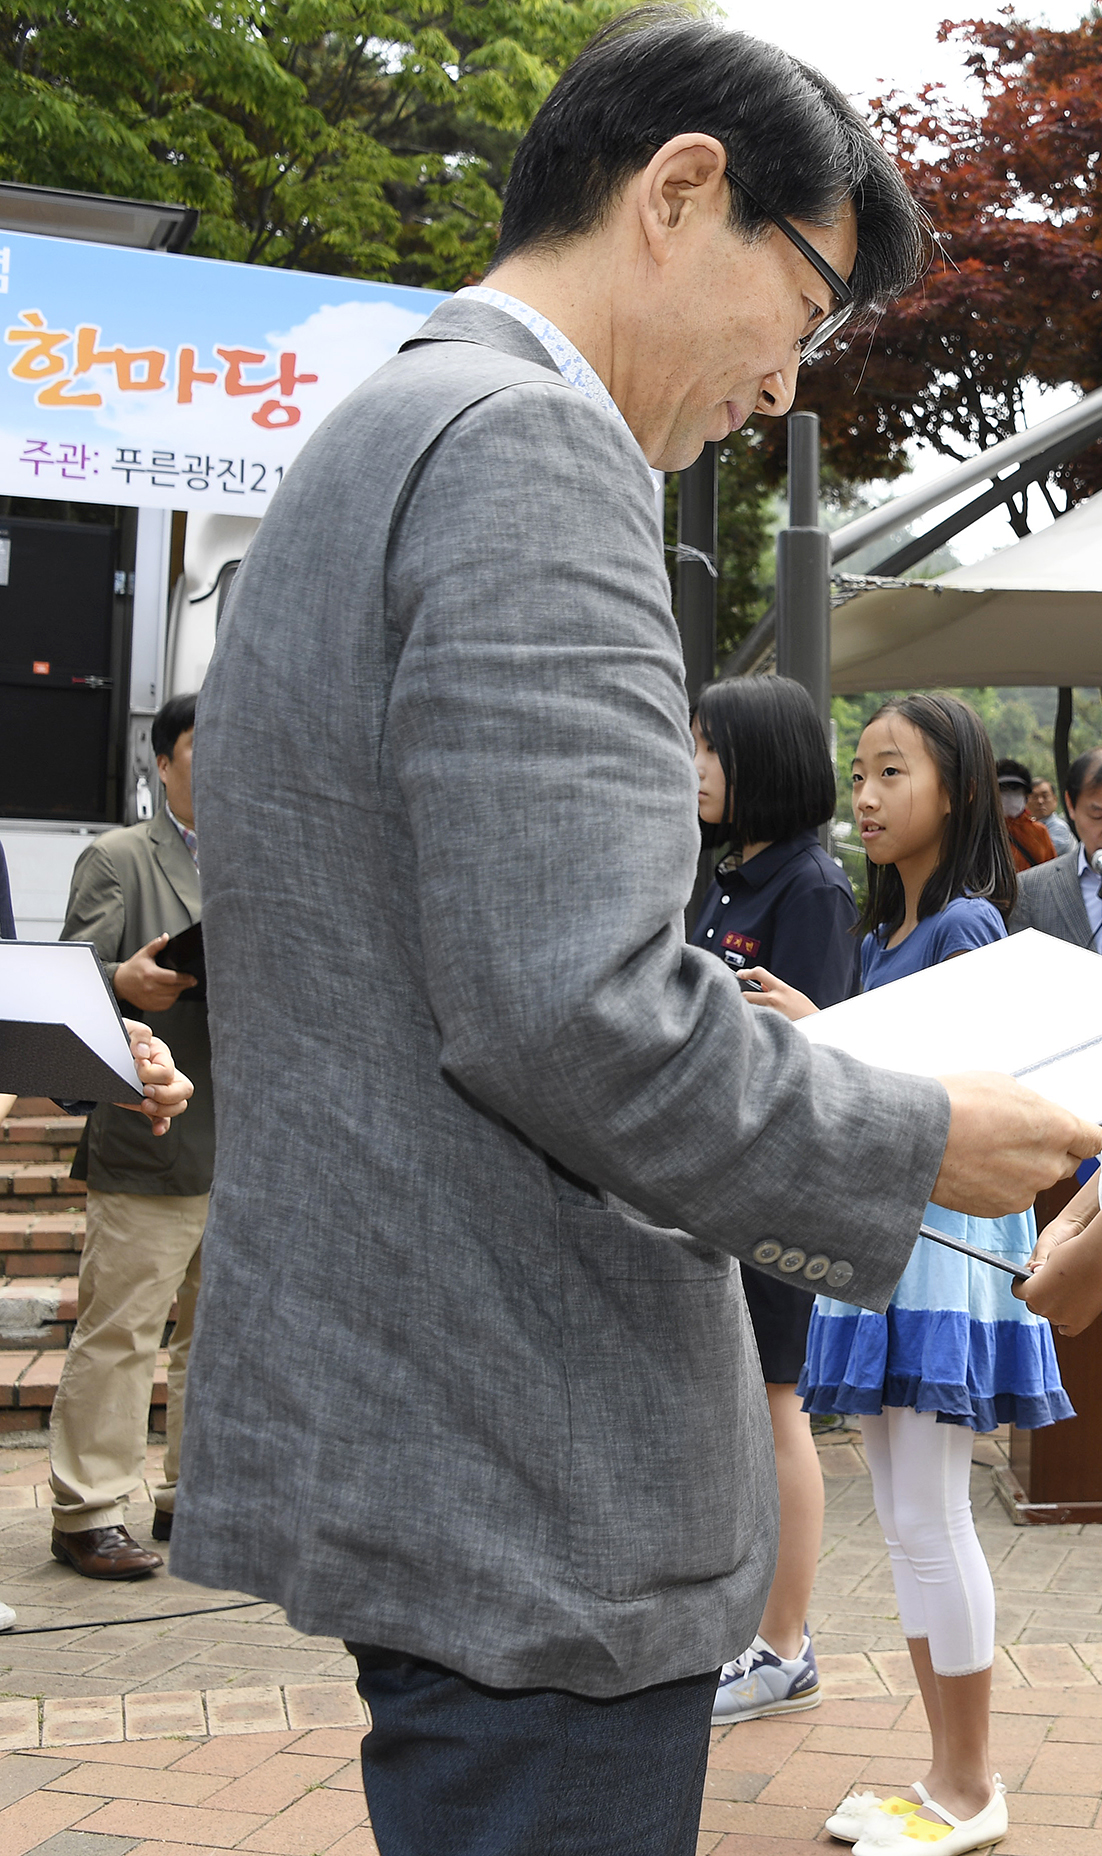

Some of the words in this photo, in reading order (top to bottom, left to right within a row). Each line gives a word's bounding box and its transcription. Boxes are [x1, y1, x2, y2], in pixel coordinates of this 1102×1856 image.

[8, 312, 318, 428] 한마당
[20, 440, 99, 479] 주관:
[111, 448, 283, 494] 푸른광진21
